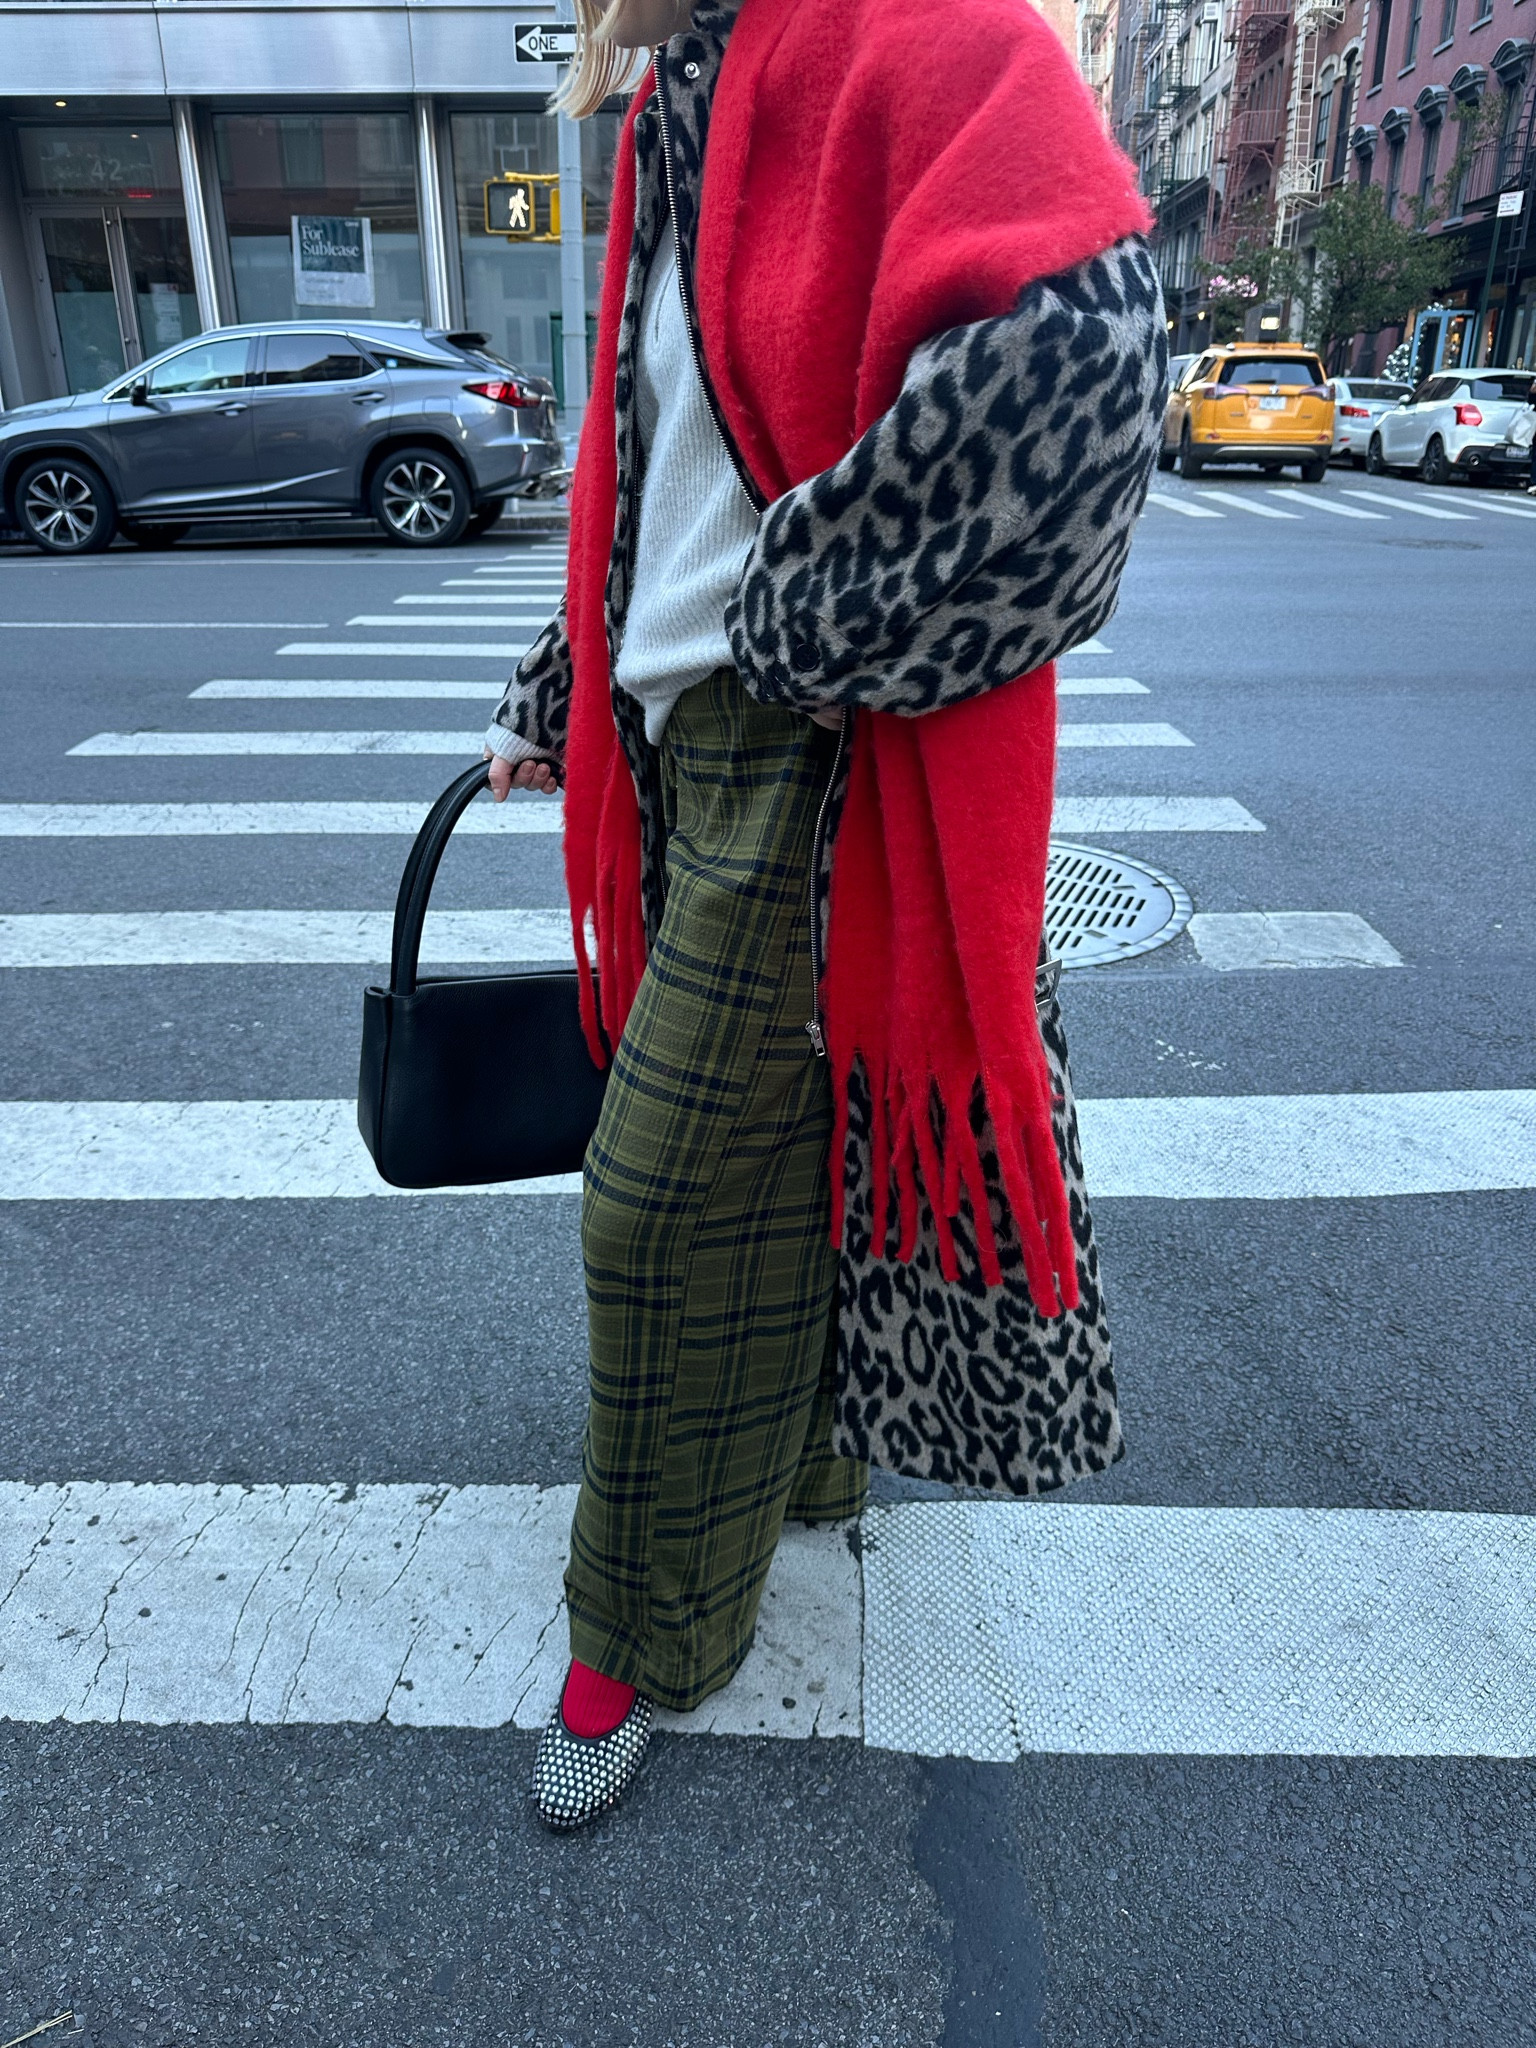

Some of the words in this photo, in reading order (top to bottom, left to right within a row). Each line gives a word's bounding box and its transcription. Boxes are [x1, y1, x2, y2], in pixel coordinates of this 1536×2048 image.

[528, 36, 558, 51] ONE
[91, 159, 123, 181] 42
[301, 225, 324, 240] For
[302, 240, 360, 257] Sublease
